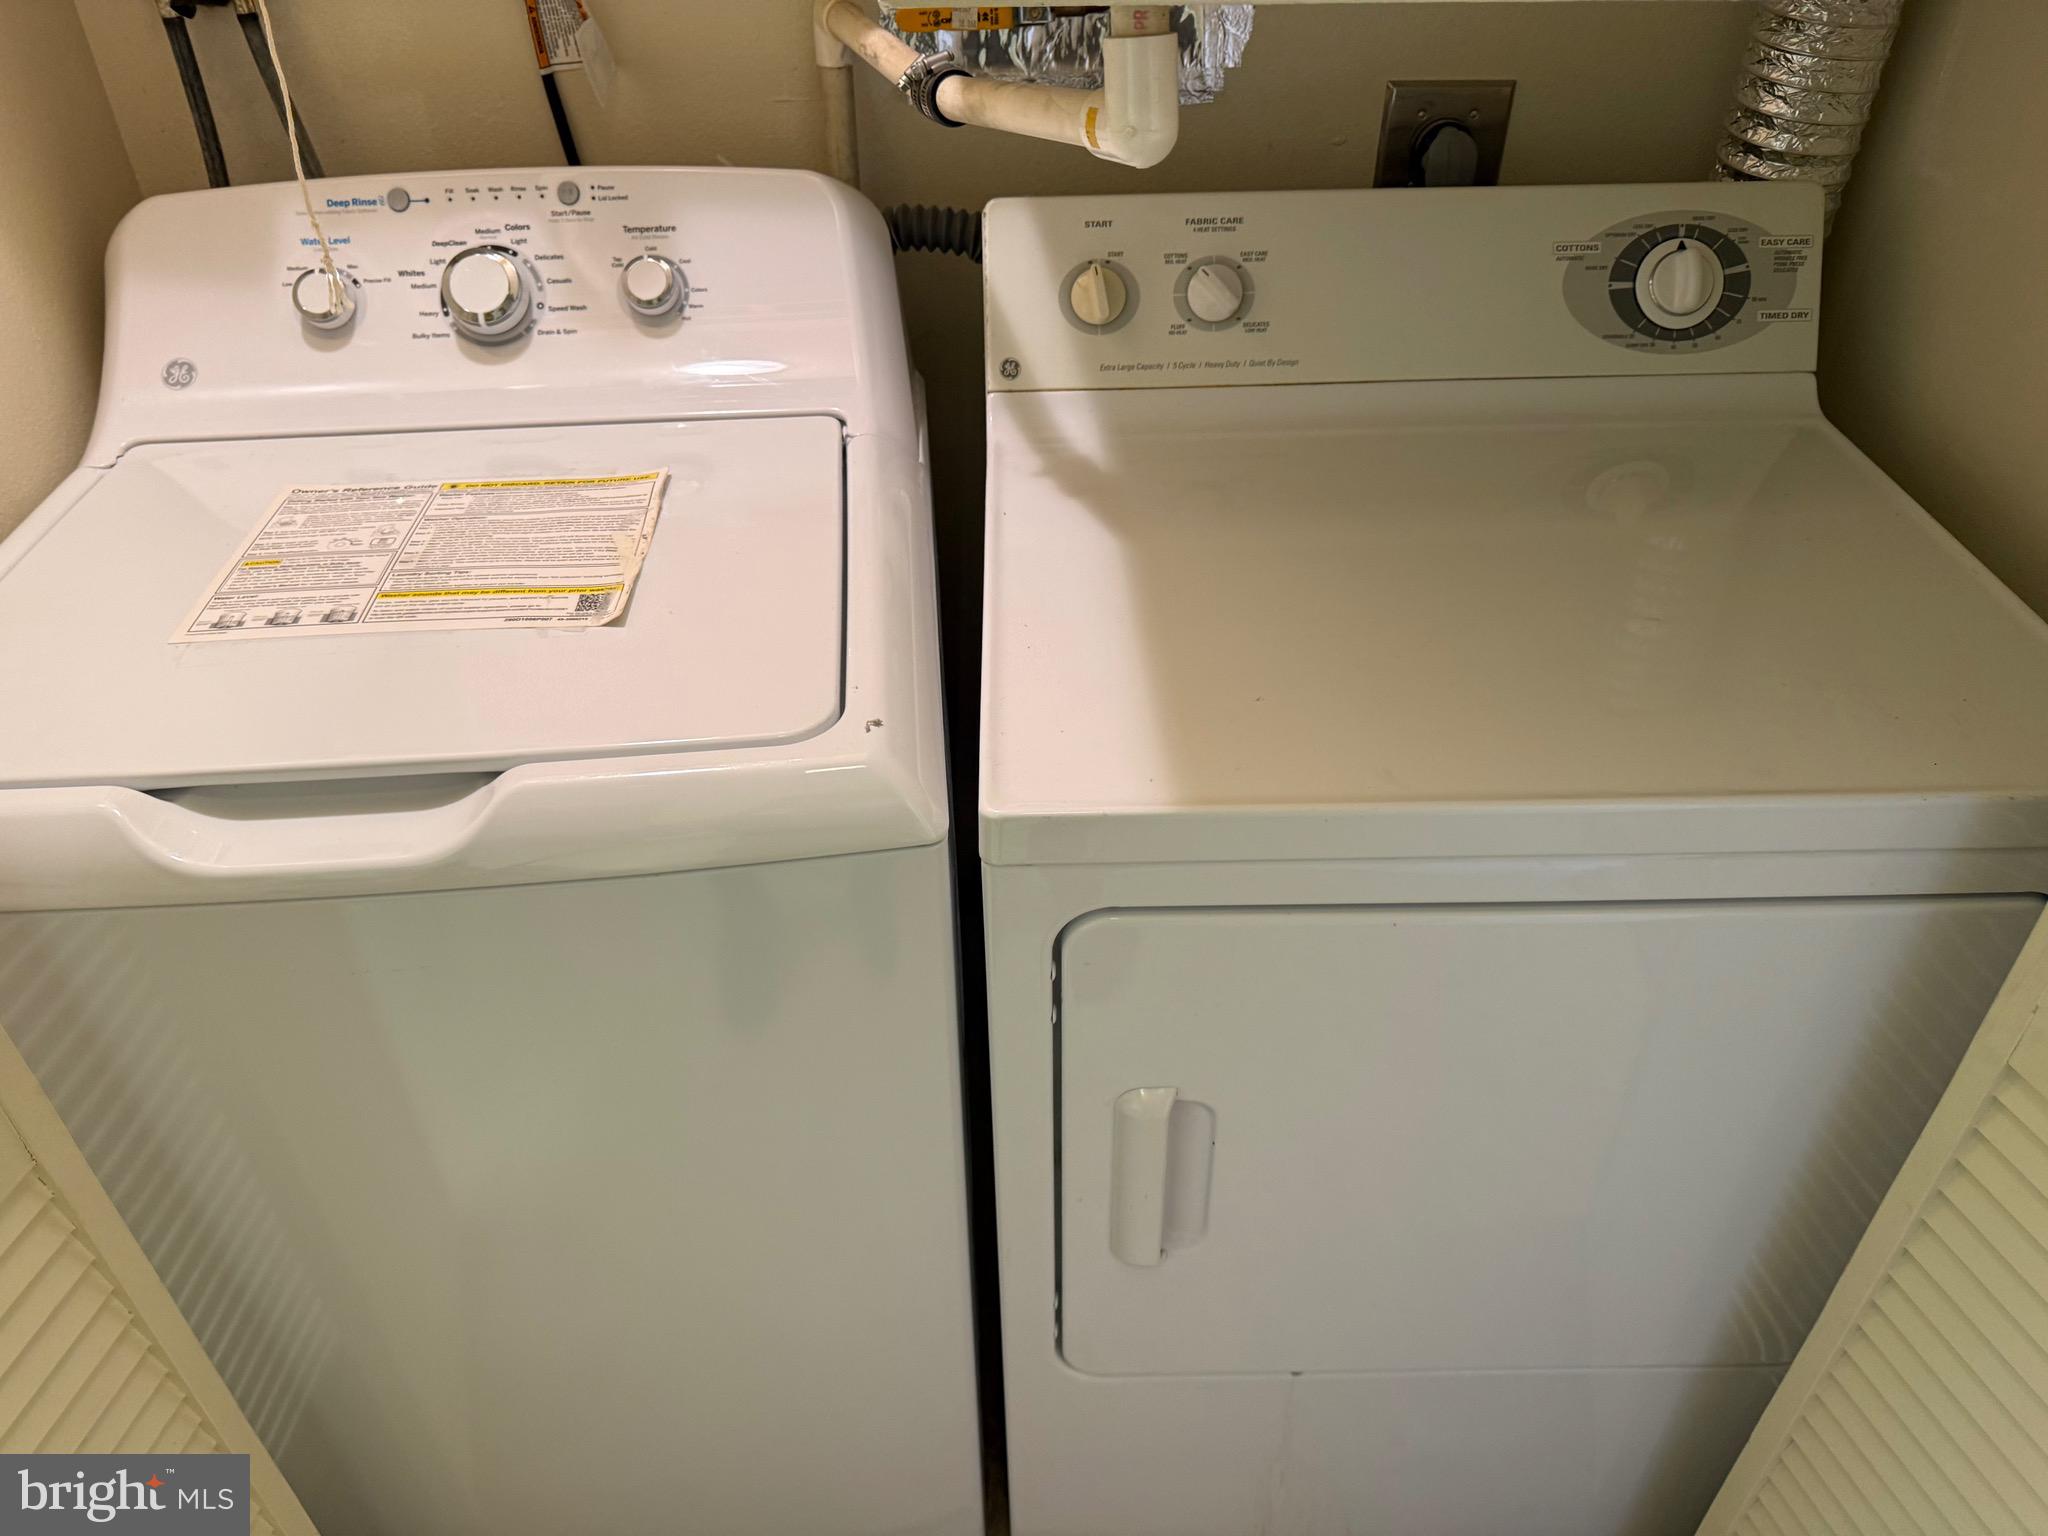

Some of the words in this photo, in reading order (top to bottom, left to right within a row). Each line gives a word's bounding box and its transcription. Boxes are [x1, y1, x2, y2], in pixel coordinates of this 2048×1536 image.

[326, 199, 350, 208] Deep
[351, 197, 378, 206] Rinse
[551, 209, 591, 217] Start/Pause
[1084, 220, 1113, 228] START
[1185, 217, 1217, 226] FABRIC
[1220, 216, 1244, 225] CARE
[623, 225, 677, 234] Temperature
[328, 236, 350, 245] Level
[432, 240, 467, 248] DeepClean
[510, 238, 528, 246] Light
[1555, 244, 1599, 252] COTTONS
[430, 258, 447, 266] Light
[548, 305, 568, 313] Speed
[419, 310, 439, 318] Heavy
[412, 332, 430, 340] Bulky
[563, 328, 578, 336] Spin
[1100, 363, 1116, 371] Extra
[1117, 363, 1135, 372] Large
[1136, 362, 1164, 372] Capacity
[1178, 362, 1196, 371] Cycle
[1204, 361, 1224, 370] Heavy
[1225, 361, 1240, 369] Duty
[1249, 359, 1266, 368] Quiet
[1267, 359, 1276, 368] By
[1277, 358, 1299, 368] Design
[342, 485, 401, 493] Reference
